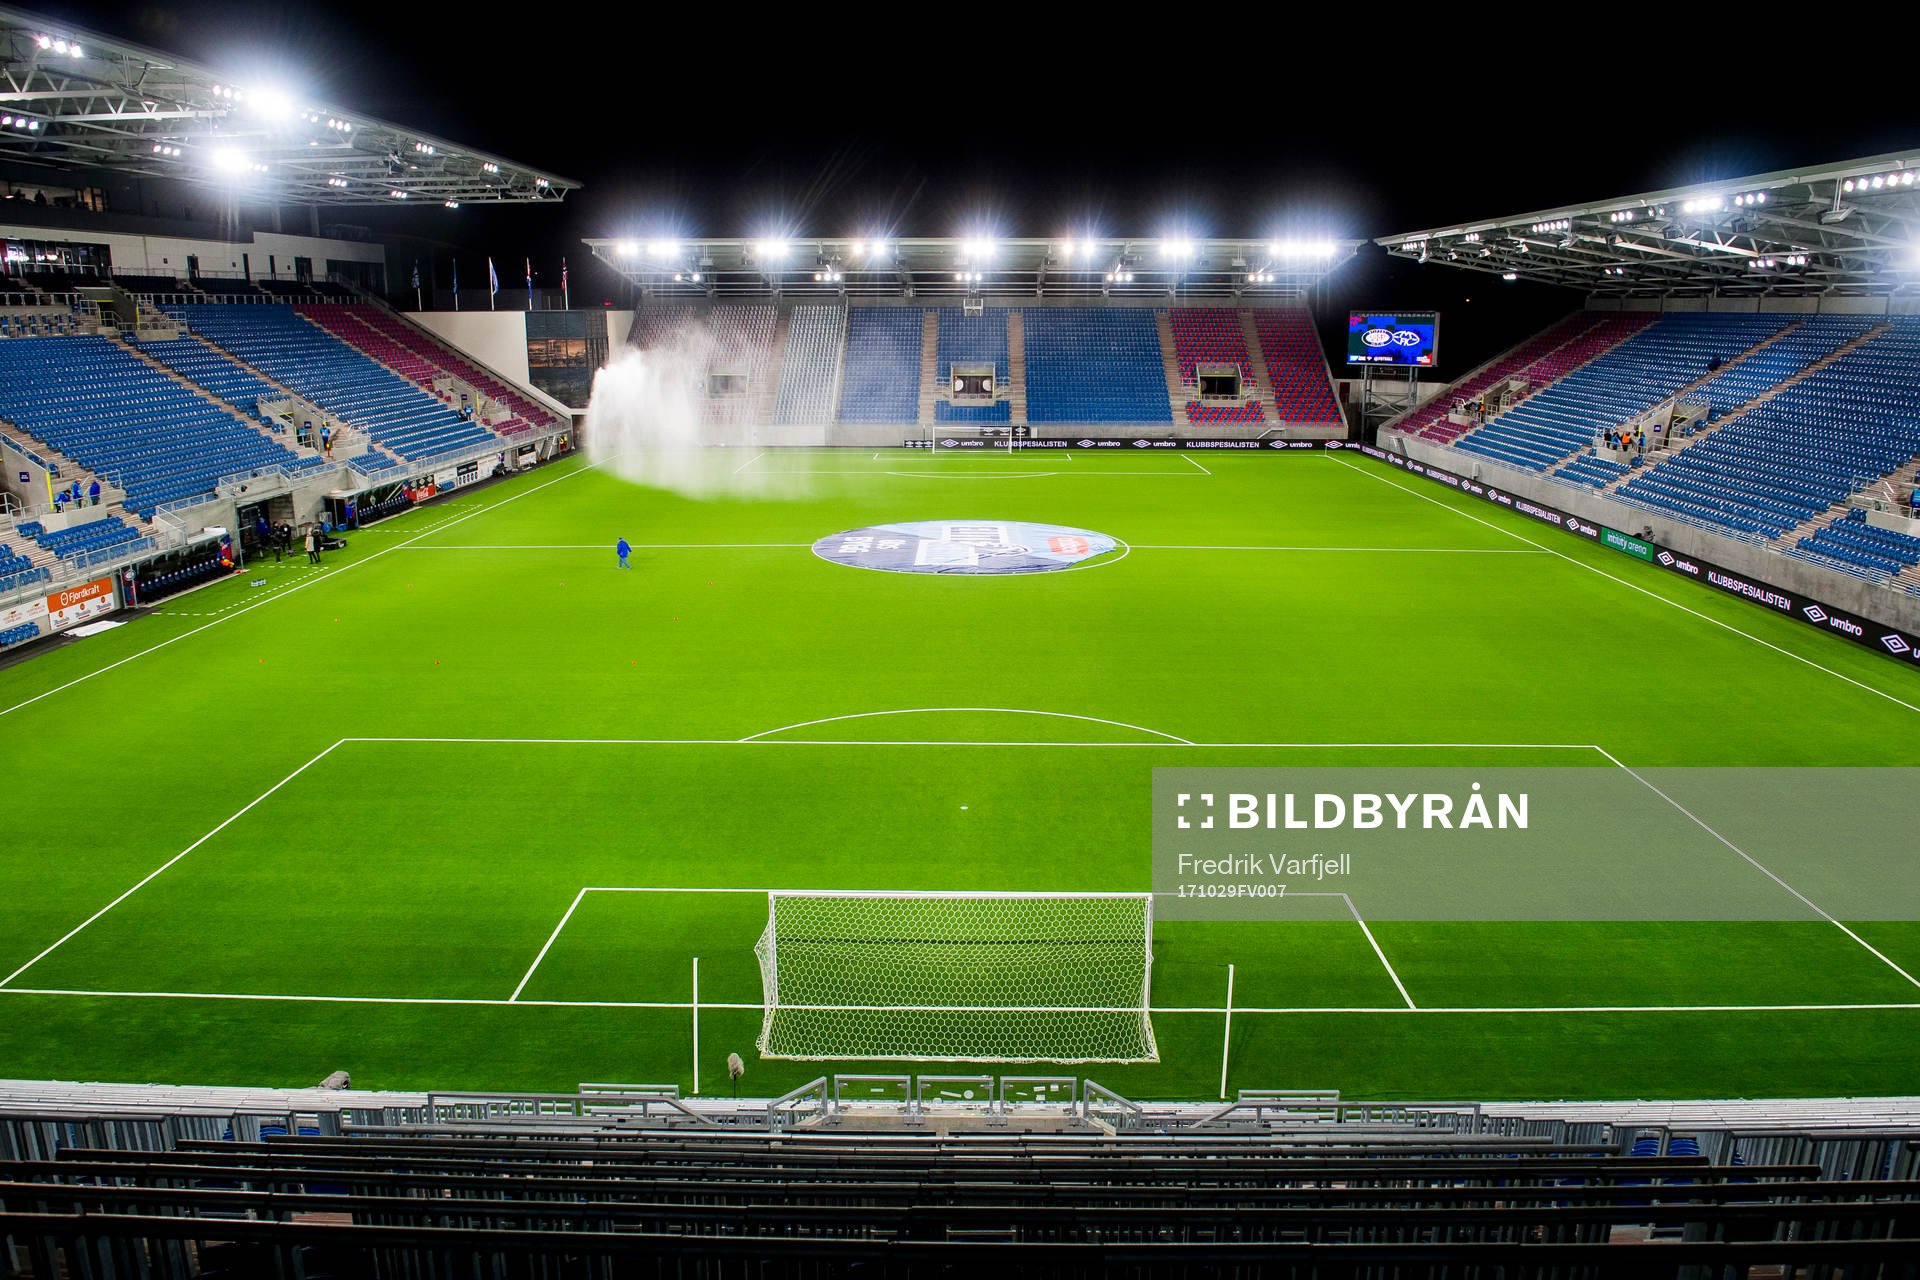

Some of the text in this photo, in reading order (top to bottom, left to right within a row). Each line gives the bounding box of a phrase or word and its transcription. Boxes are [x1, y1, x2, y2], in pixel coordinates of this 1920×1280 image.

[1580, 524, 1597, 537] umbro
[1628, 541, 1647, 555] arena
[69, 584, 100, 604] Fjordkraft
[1676, 558, 1699, 575] umbro
[1708, 570, 1791, 611] KLUBBSPESIALISTEN
[1830, 615, 1863, 637] umbro
